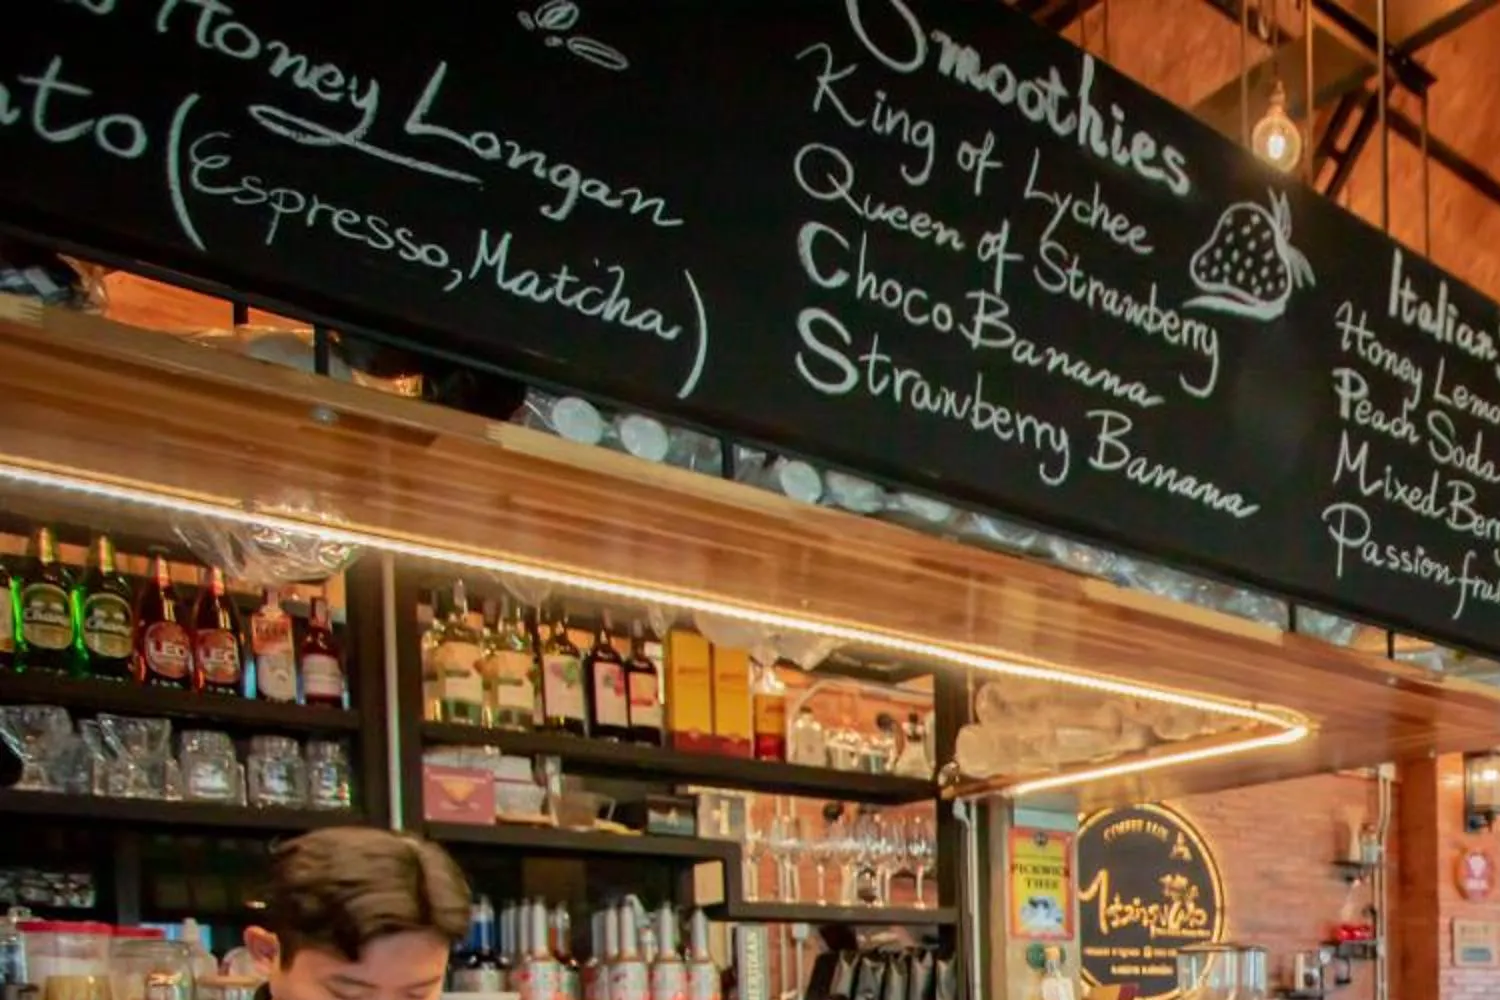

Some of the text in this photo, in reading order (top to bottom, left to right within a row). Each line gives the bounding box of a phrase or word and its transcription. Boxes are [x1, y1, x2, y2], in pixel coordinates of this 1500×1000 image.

[404, 60, 684, 226] Longan
[796, 42, 1154, 256] King of Lychee
[794, 142, 1220, 398] Queen of Strawberry
[799, 221, 1164, 408] Choco Banana
[1387, 248, 1498, 363] Italian
[796, 308, 1260, 519] Strawberry Banana
[1332, 367, 1421, 446] Peach
[1334, 300, 1423, 409] Honey
[1332, 430, 1447, 517] Mixed
